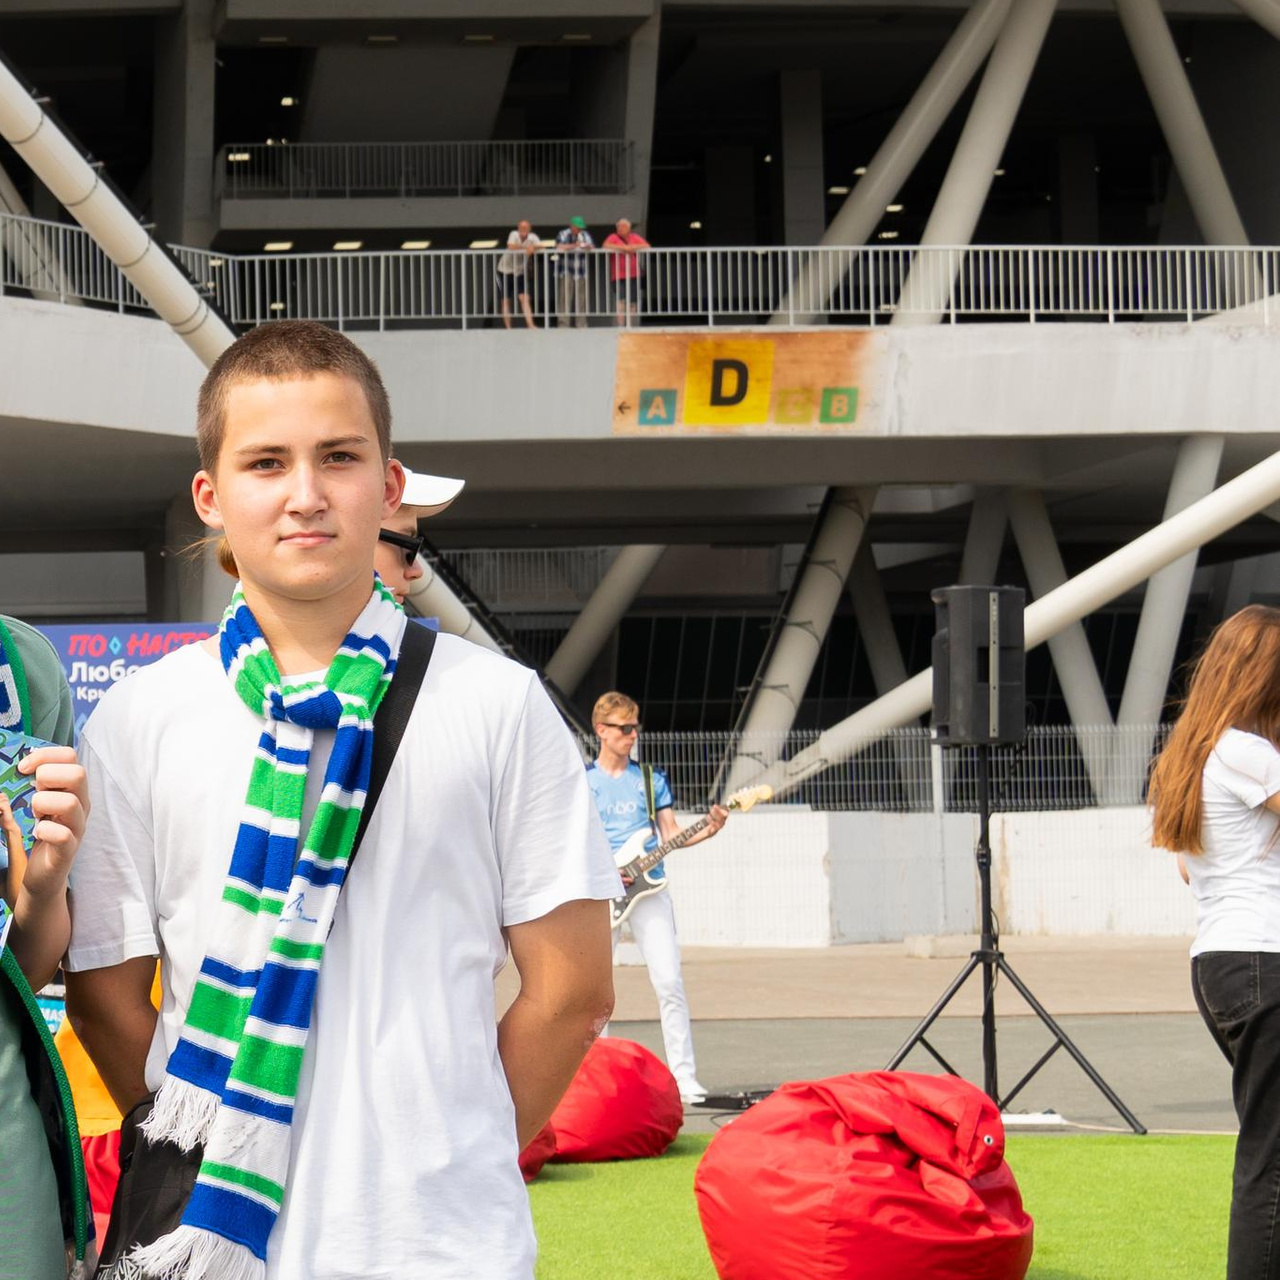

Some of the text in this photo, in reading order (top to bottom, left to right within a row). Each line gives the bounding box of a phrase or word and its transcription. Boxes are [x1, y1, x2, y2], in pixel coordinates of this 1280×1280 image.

[646, 395, 667, 419] A
[709, 358, 749, 407] D
[829, 395, 849, 418] B
[67, 631, 211, 657] ПО НАСТ
[76, 686, 107, 703] Кр
